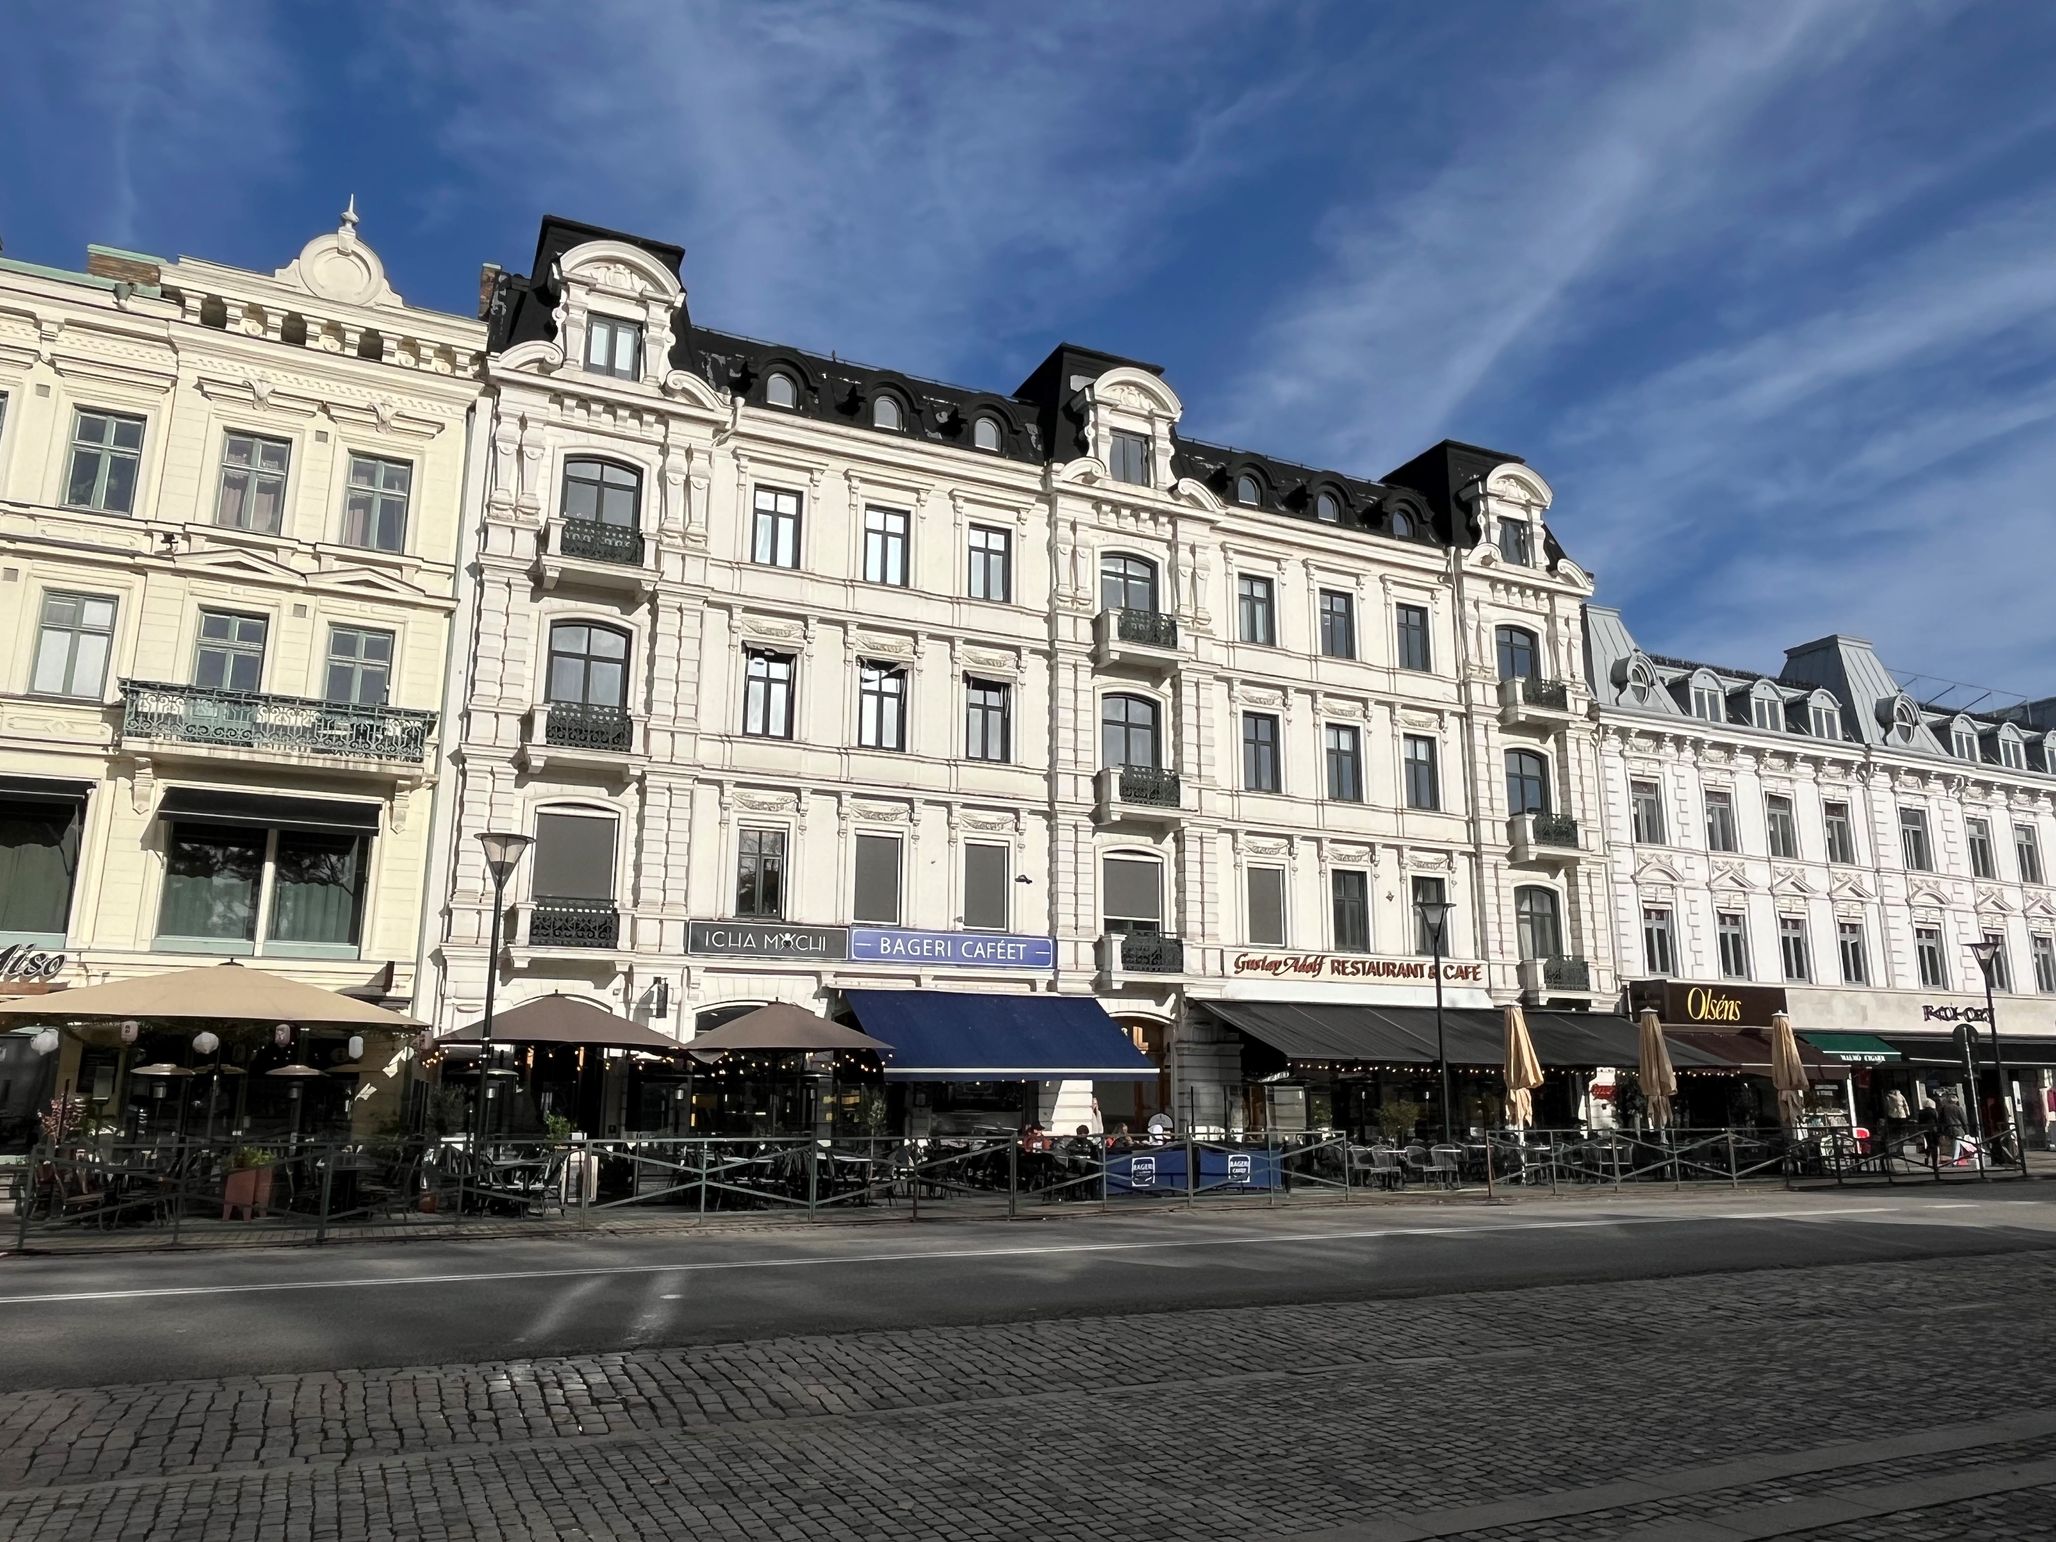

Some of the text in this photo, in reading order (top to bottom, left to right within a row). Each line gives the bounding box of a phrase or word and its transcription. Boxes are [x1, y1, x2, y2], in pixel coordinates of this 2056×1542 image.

[705, 931, 756, 949] ICHA
[880, 937, 1027, 960] BAGERI CAFÉET
[1234, 953, 1283, 975] Gustav
[1273, 955, 1326, 978] Adolf
[1330, 959, 1426, 979] RESTAURANT
[1687, 987, 1742, 1021] Olséns
